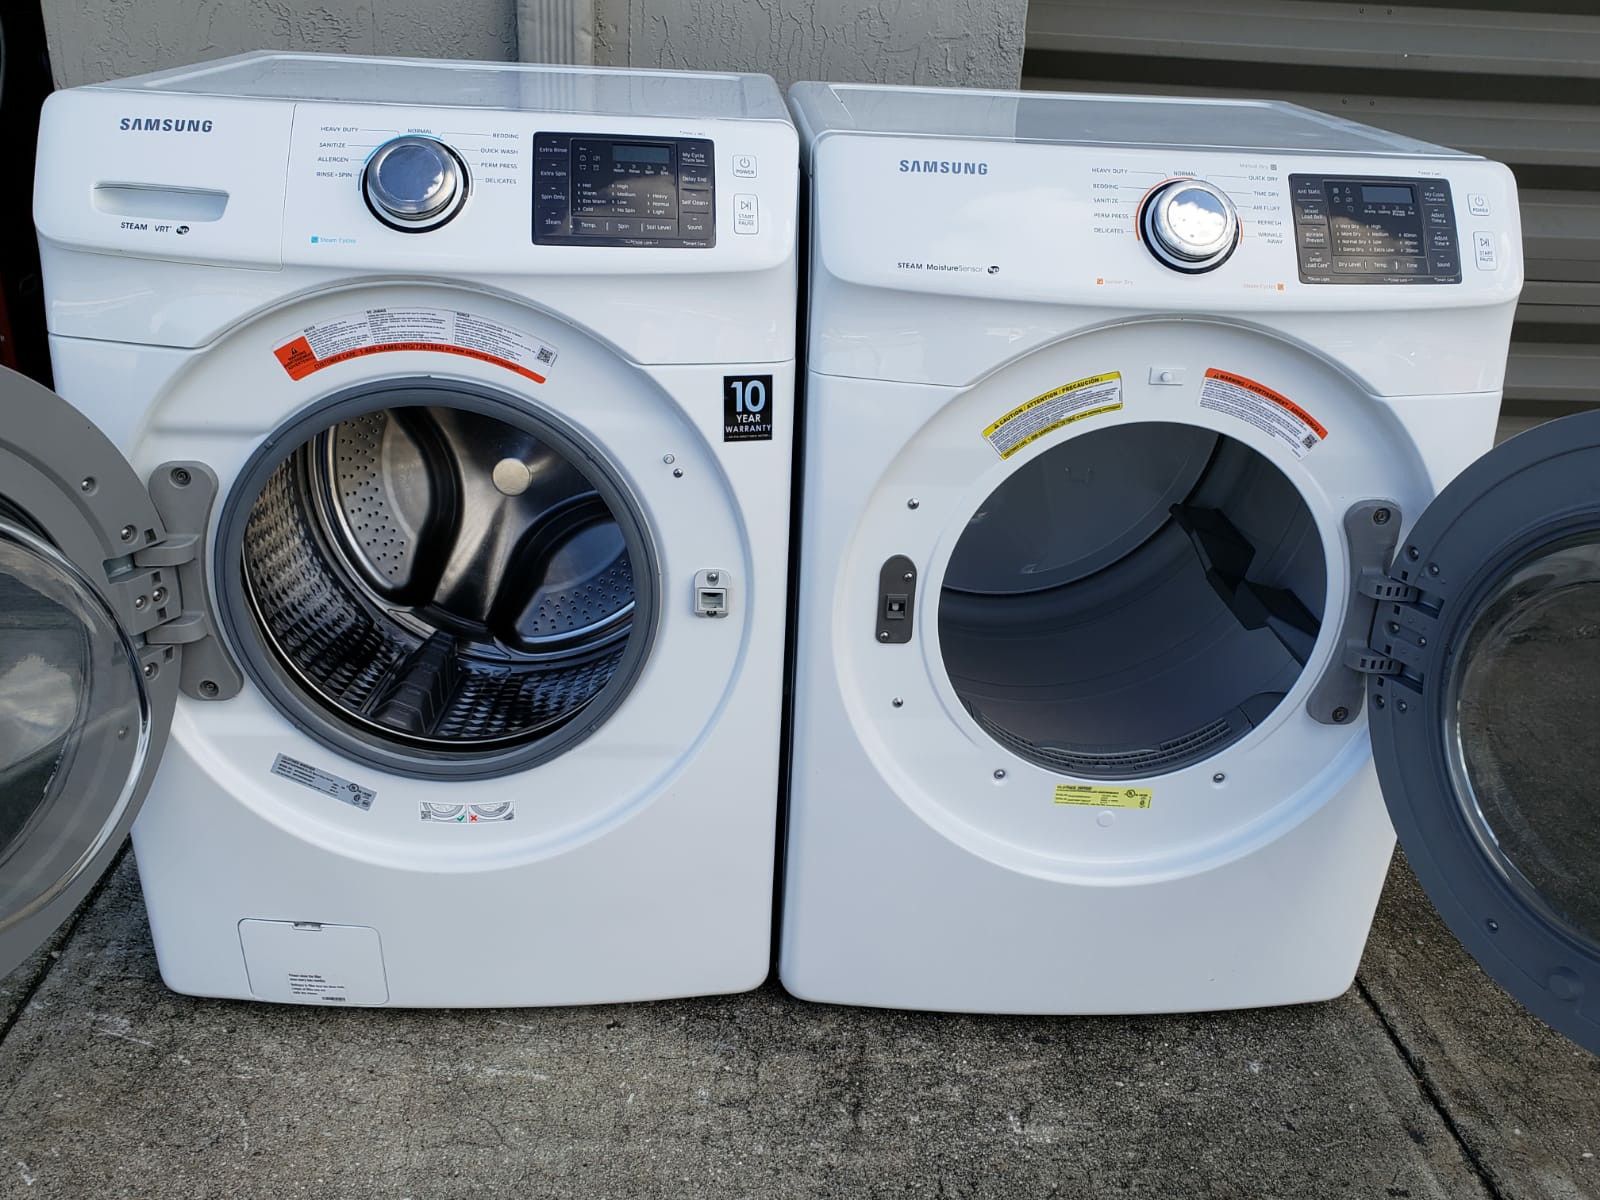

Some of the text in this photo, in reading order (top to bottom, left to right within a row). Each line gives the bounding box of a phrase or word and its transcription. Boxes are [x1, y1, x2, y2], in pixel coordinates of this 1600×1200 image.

[120, 118, 213, 132] SAMSUNG
[899, 160, 988, 175] SAMSUNG
[120, 222, 148, 231] STEAM
[927, 264, 983, 273] MoistureSensor
[731, 380, 766, 412] 10
[1000, 409, 1023, 425] CAUTION
[1027, 391, 1058, 409] ATTENTION
[1062, 377, 1099, 392] PRECAUCIÓN
[736, 414, 761, 423] YEAR
[725, 424, 771, 433] WARRANTY
